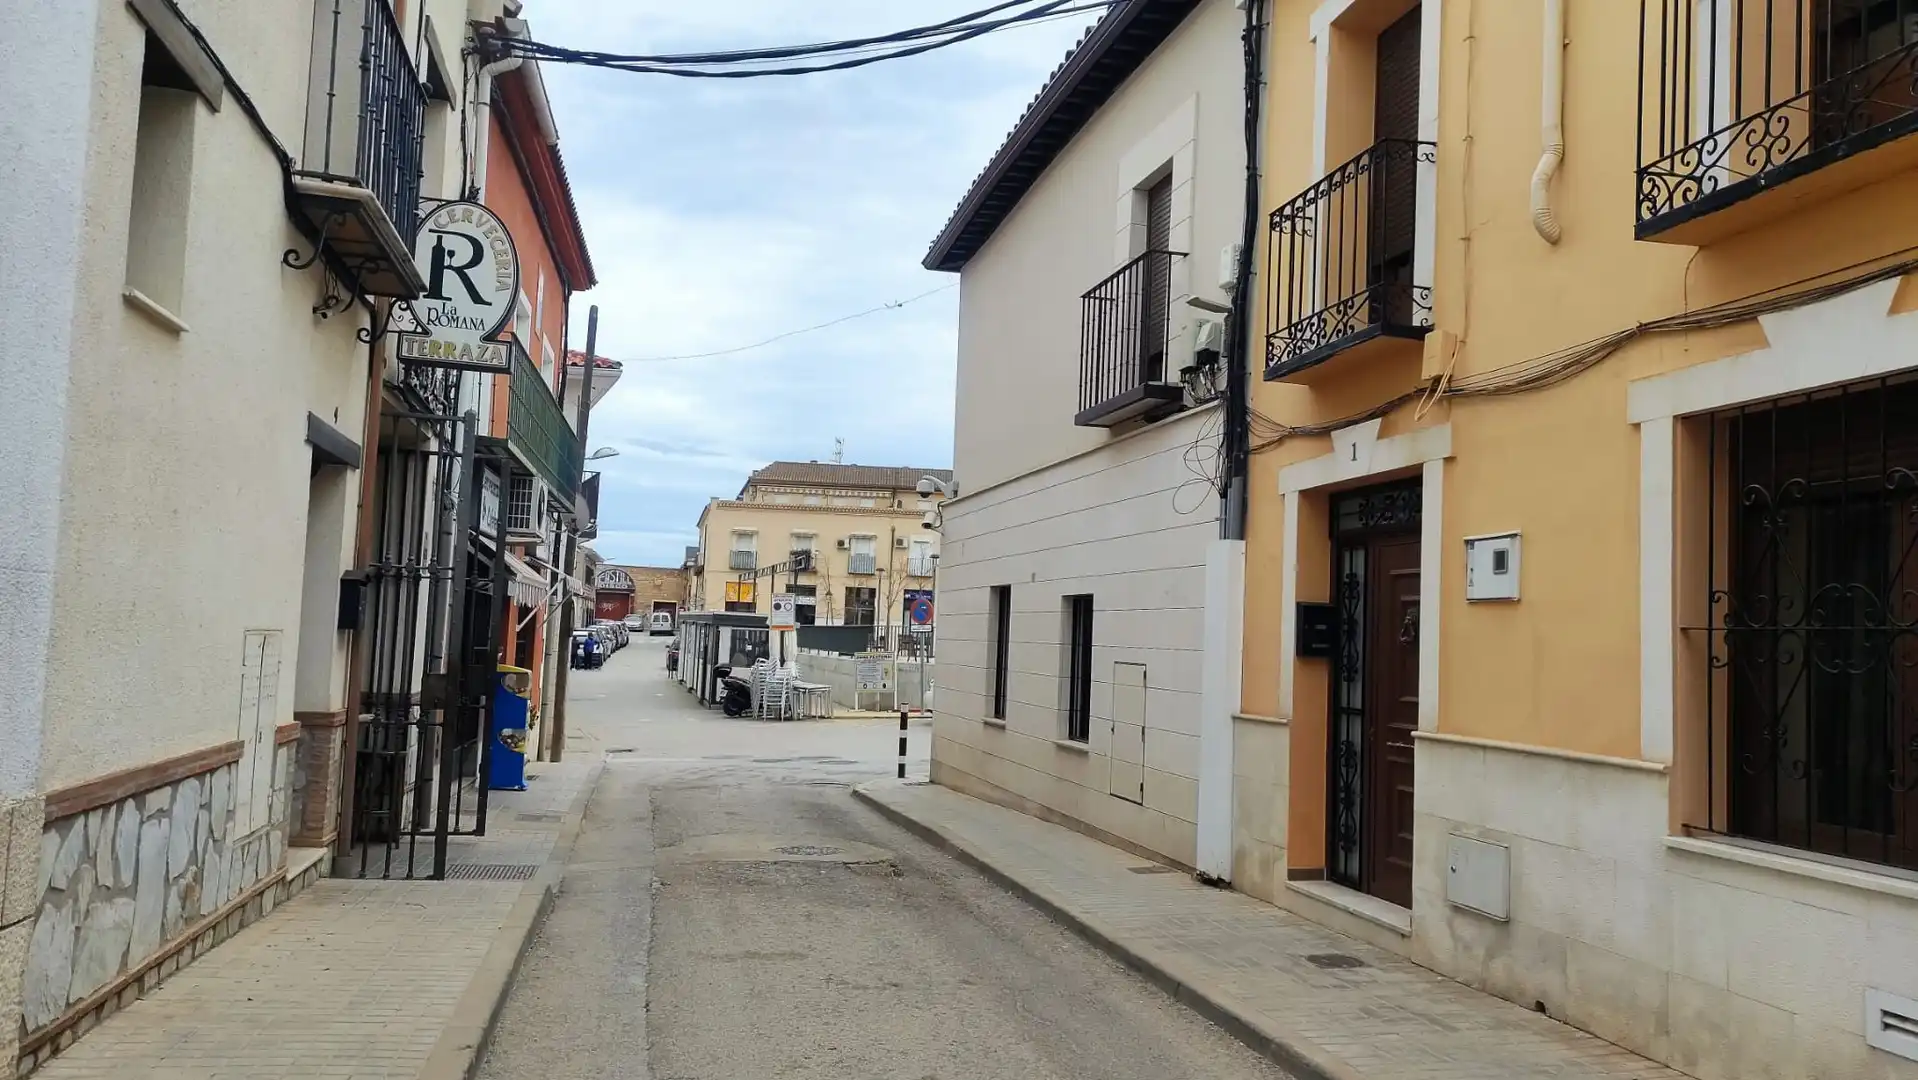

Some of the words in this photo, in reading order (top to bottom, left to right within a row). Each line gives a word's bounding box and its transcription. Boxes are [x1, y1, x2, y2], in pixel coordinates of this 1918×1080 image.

[427, 307, 486, 331] ROMANA
[441, 302, 457, 315] La
[405, 338, 503, 364] TERRAZA
[1351, 442, 1358, 461] 1
